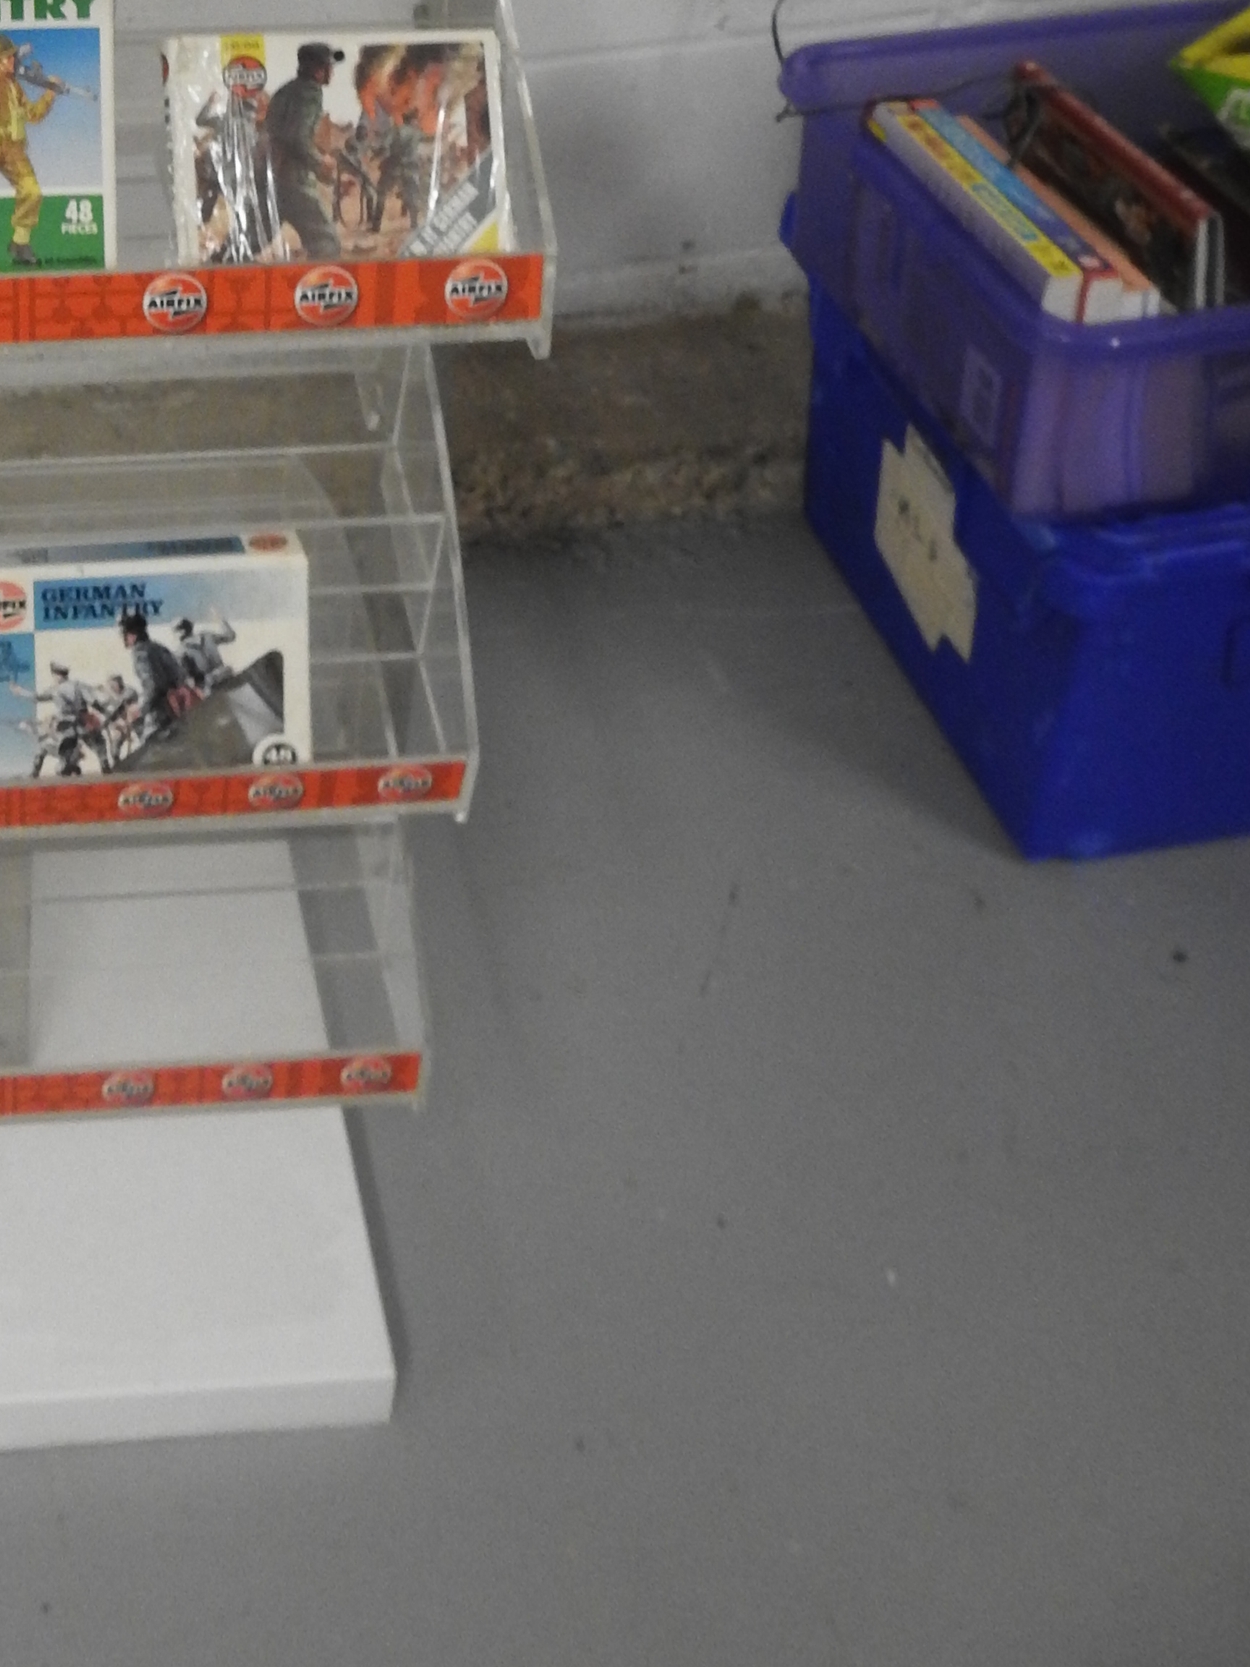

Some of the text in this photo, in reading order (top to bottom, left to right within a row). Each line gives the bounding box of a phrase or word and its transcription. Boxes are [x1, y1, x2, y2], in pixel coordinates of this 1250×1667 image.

[65, 199, 93, 224] 48
[299, 290, 354, 303] AIRFIX
[450, 283, 504, 297] AIRFIX
[147, 297, 204, 311] AIRFIX
[40, 583, 147, 604] GERMAN
